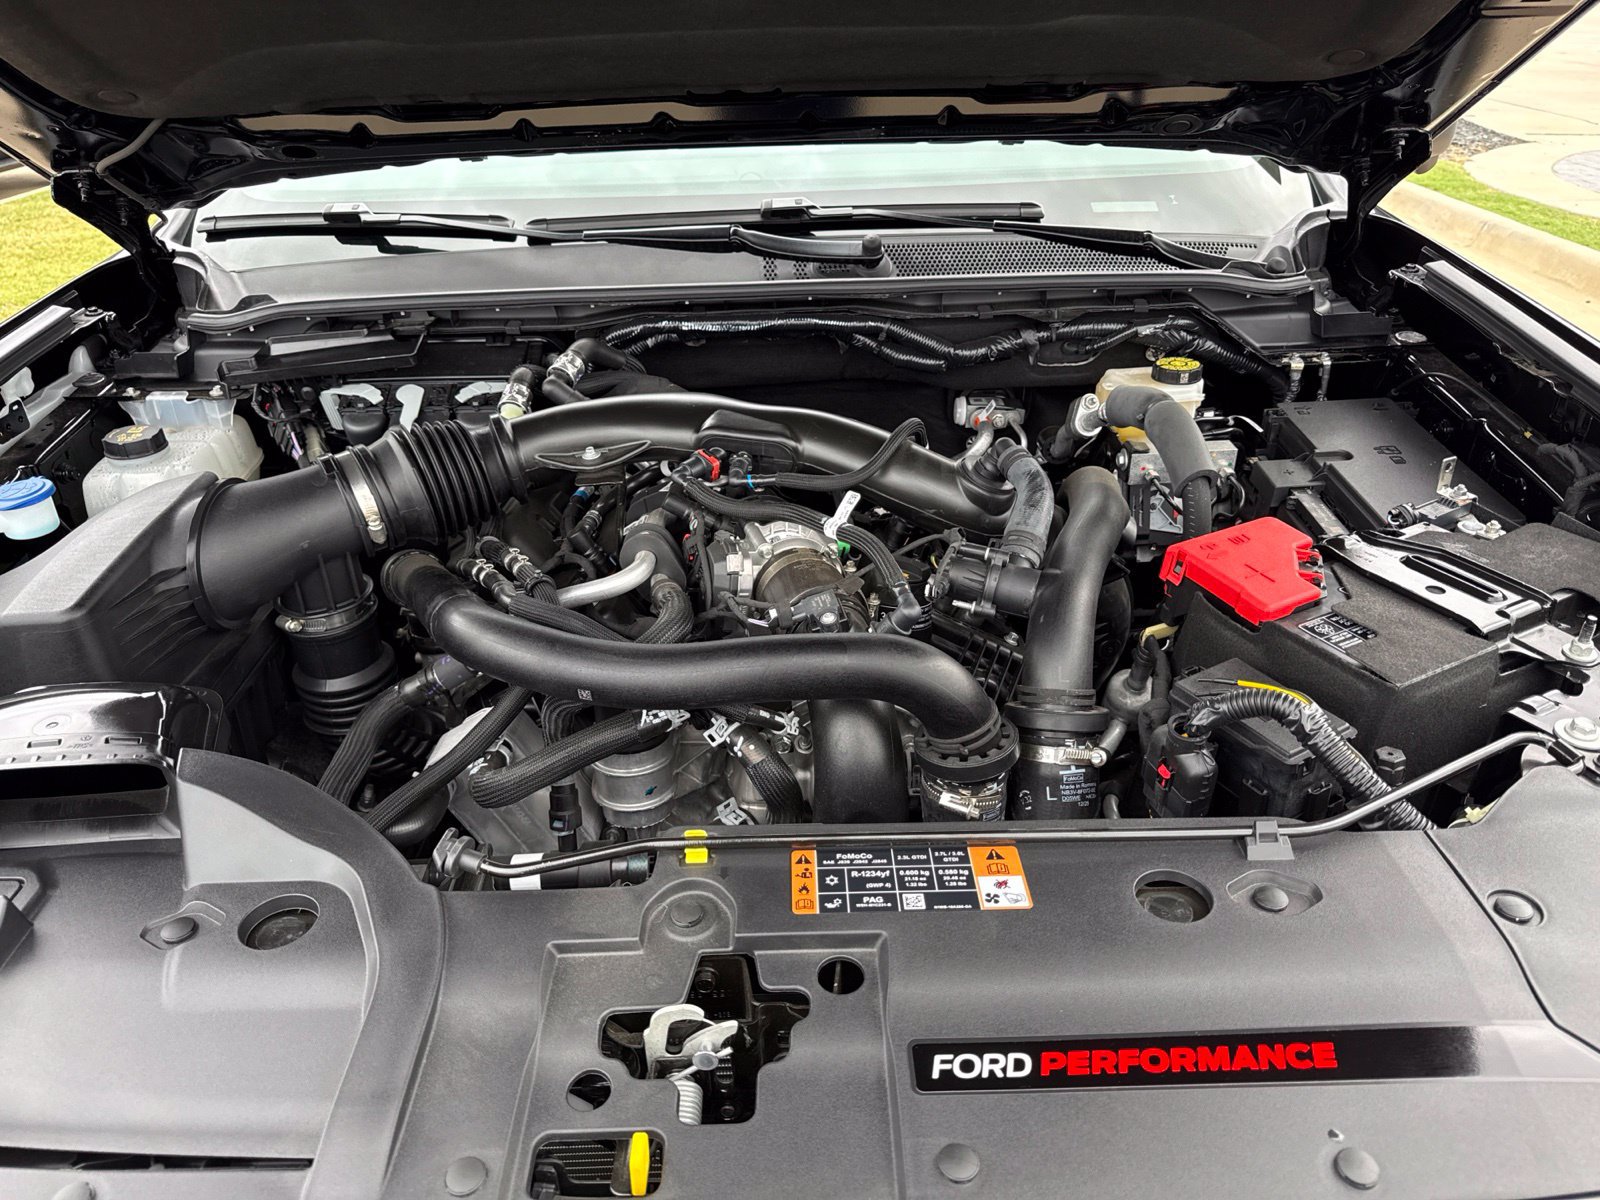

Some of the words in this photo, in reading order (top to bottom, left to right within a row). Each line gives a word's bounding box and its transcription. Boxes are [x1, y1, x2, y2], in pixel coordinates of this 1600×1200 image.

[1046, 786, 1057, 800] L
[851, 870, 890, 878] R-1234yf
[920, 869, 930, 877] kg
[931, 1052, 1033, 1080] FORD
[1040, 1041, 1339, 1076] PERFORMANCE
